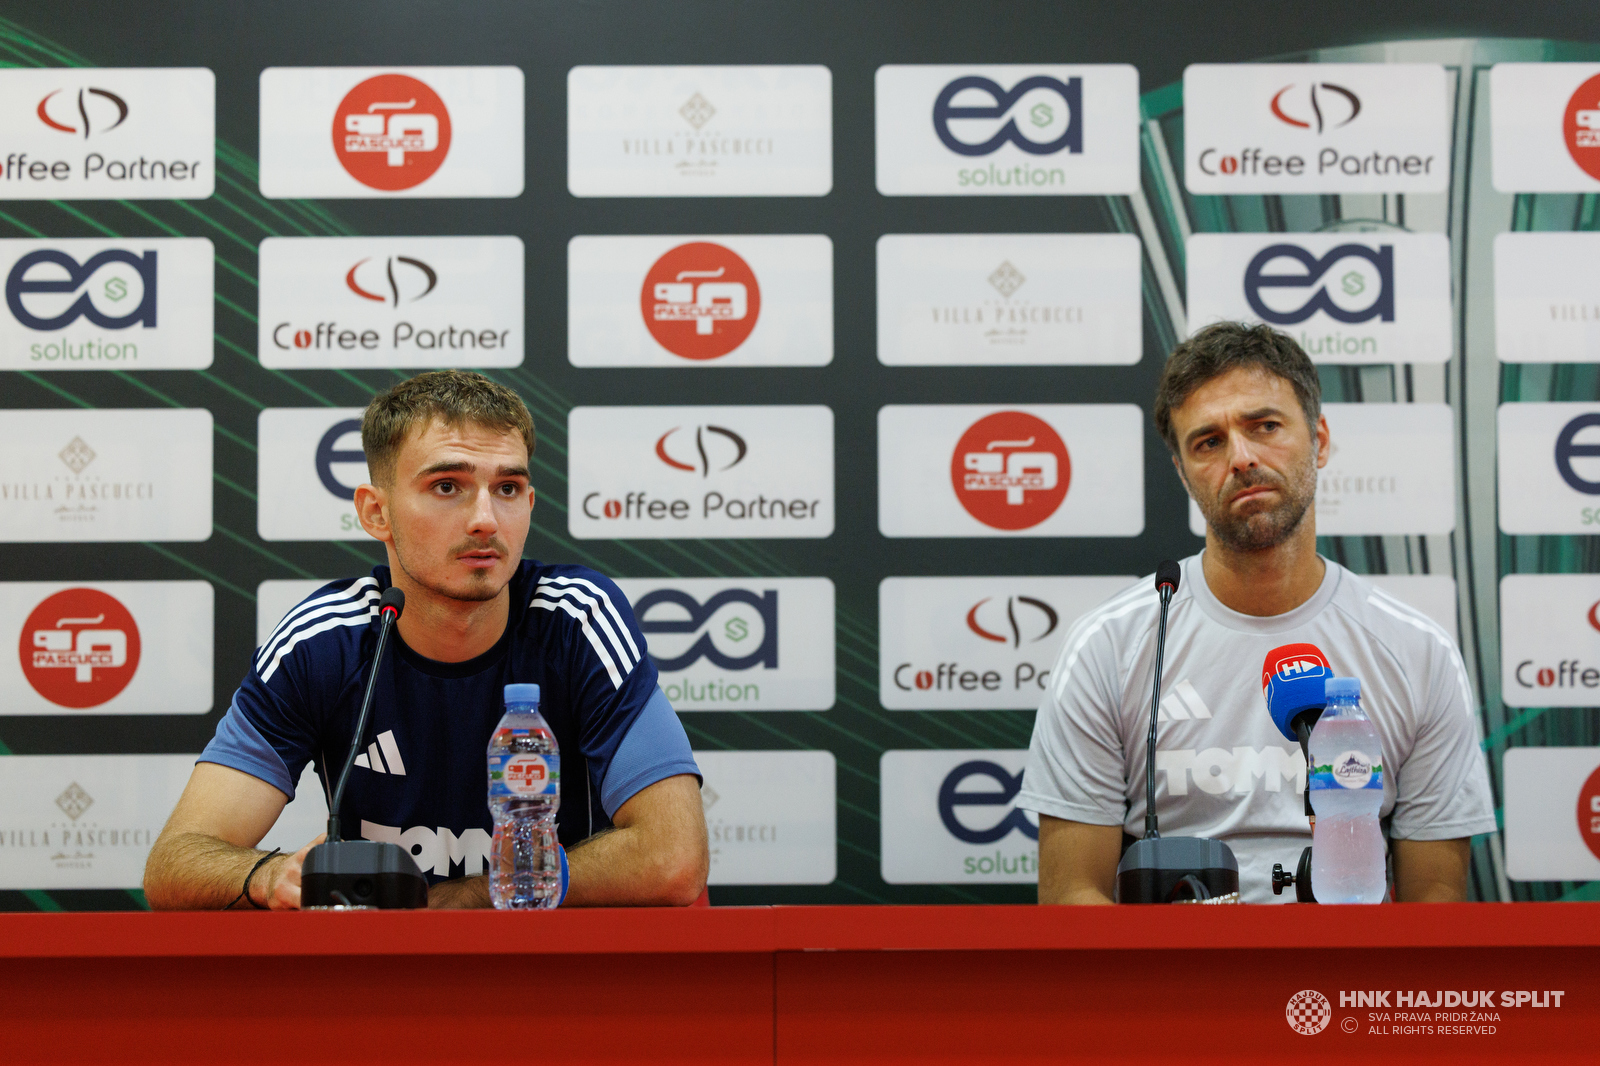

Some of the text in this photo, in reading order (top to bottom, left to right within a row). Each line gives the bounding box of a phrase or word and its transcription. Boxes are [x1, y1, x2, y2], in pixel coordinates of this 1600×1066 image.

[0, 152, 200, 181] ffee Partner
[958, 163, 1066, 186] solution
[1199, 147, 1434, 176] Coffee Partner
[273, 321, 510, 350] Coffee Partner
[1300, 331, 1377, 355] lution
[29, 338, 138, 361] solution
[2, 483, 153, 500] VILLA PASCUCCI
[583, 491, 820, 520] Coffee Partner
[894, 662, 1001, 691] Coffee
[1516, 660, 1600, 689] Coffe
[661, 678, 760, 703] olution
[62, 830, 150, 847] PASCUCCI
[964, 849, 1037, 875] soluti
